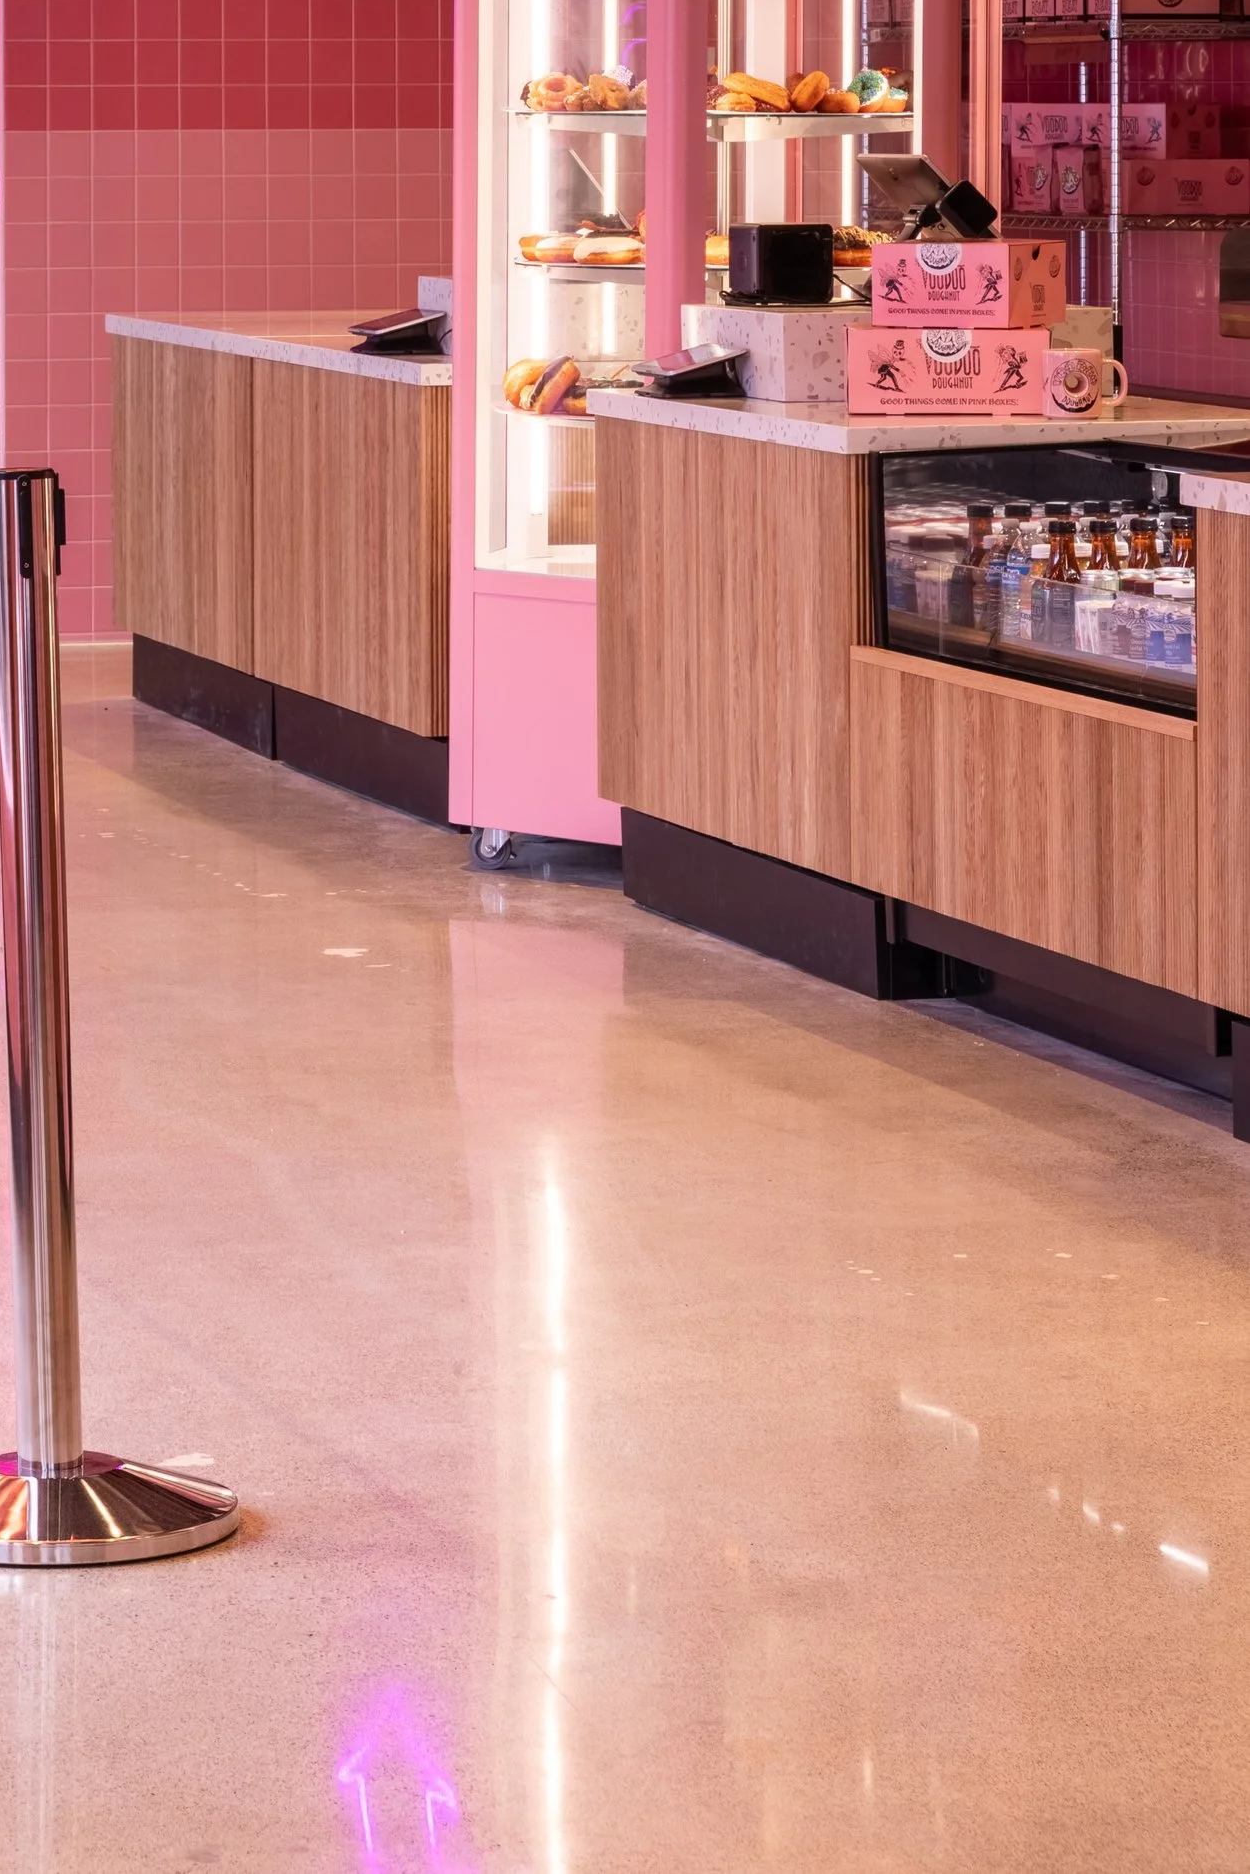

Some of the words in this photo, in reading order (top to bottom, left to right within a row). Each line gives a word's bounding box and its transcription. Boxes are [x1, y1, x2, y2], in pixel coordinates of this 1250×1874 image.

[928, 291, 960, 302] DOUGHNUT
[887, 307, 906, 315] GOOD
[907, 307, 930, 315] THINGS
[932, 376, 973, 390] DOUGHNUT
[880, 397, 904, 406] GOOD
[904, 397, 935, 406] THINGS
[935, 397, 958, 406] COME
[959, 397, 968, 405] IN
[968, 398, 988, 406] PINK
